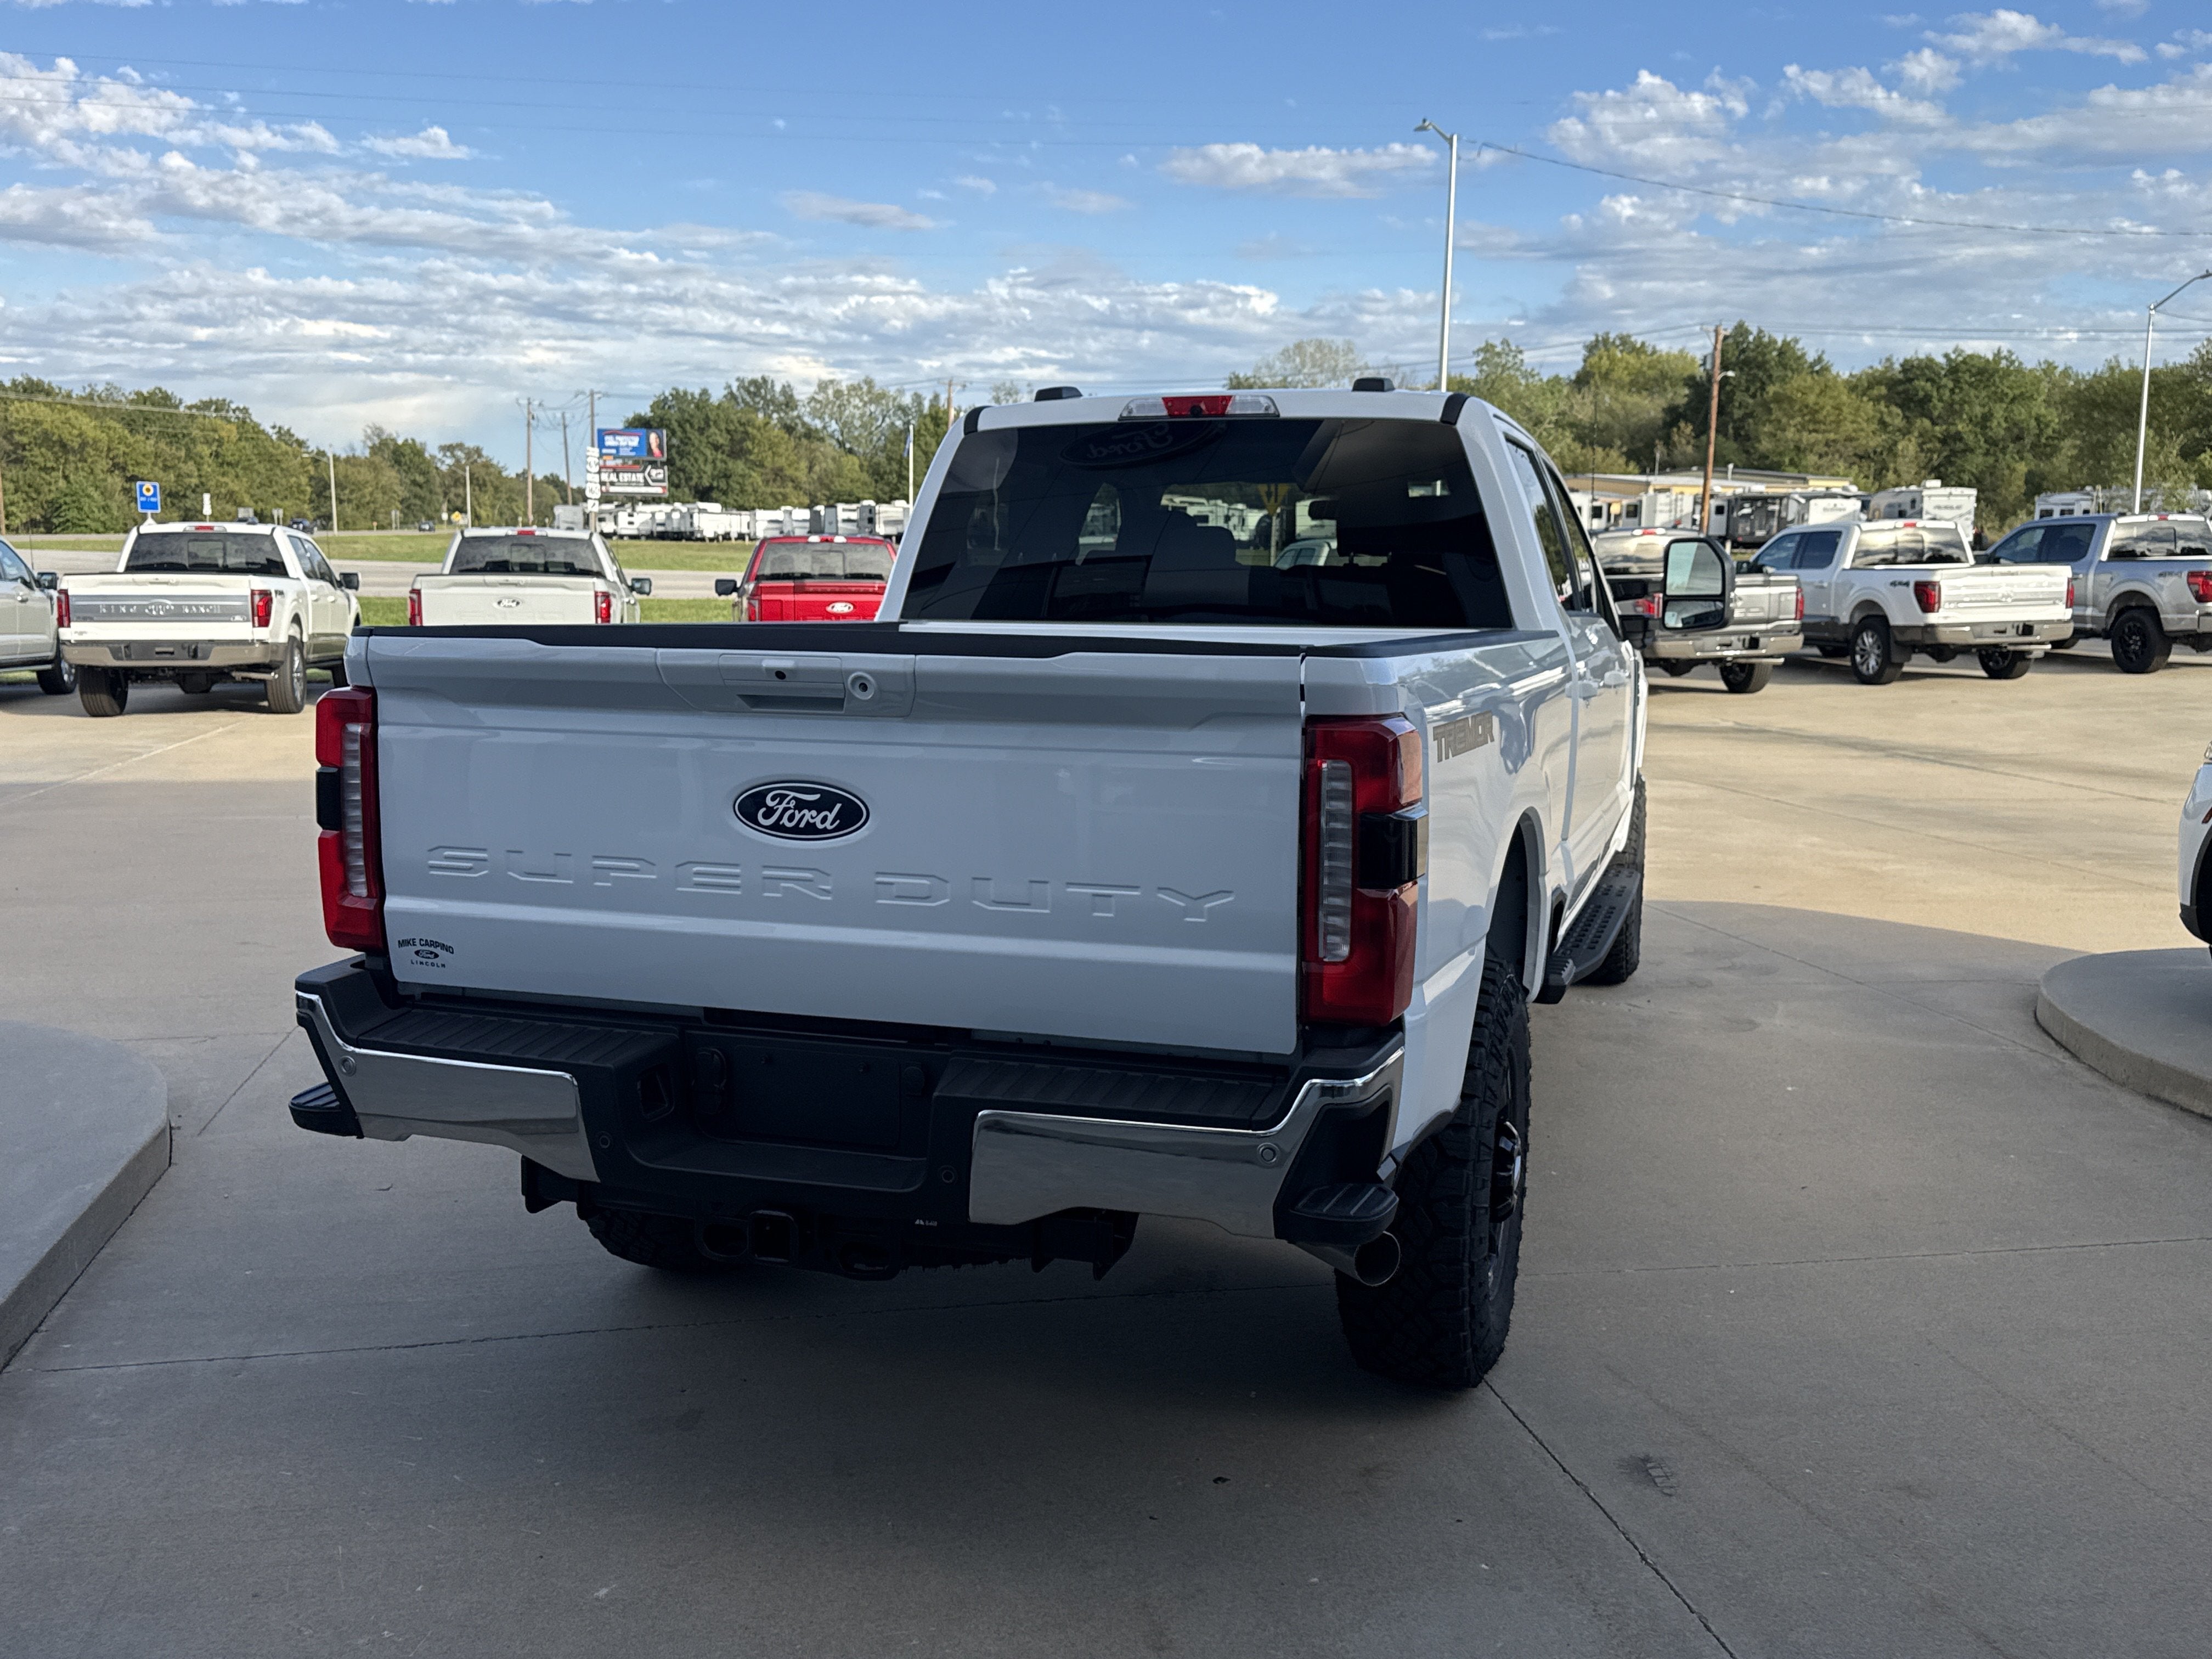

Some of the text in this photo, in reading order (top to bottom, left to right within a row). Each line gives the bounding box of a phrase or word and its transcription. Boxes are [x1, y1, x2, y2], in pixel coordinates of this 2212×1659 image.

[618, 472, 645, 483] ESTATE
[1433, 710, 1495, 763] TREMOR
[758, 789, 842, 830] Ford
[428, 846, 1234, 922] SUPER DUTY
[398, 938, 454, 954] MIKE CARPINO
[419, 950, 435, 958] Ford
[411, 960, 445, 968] LINCOLN
